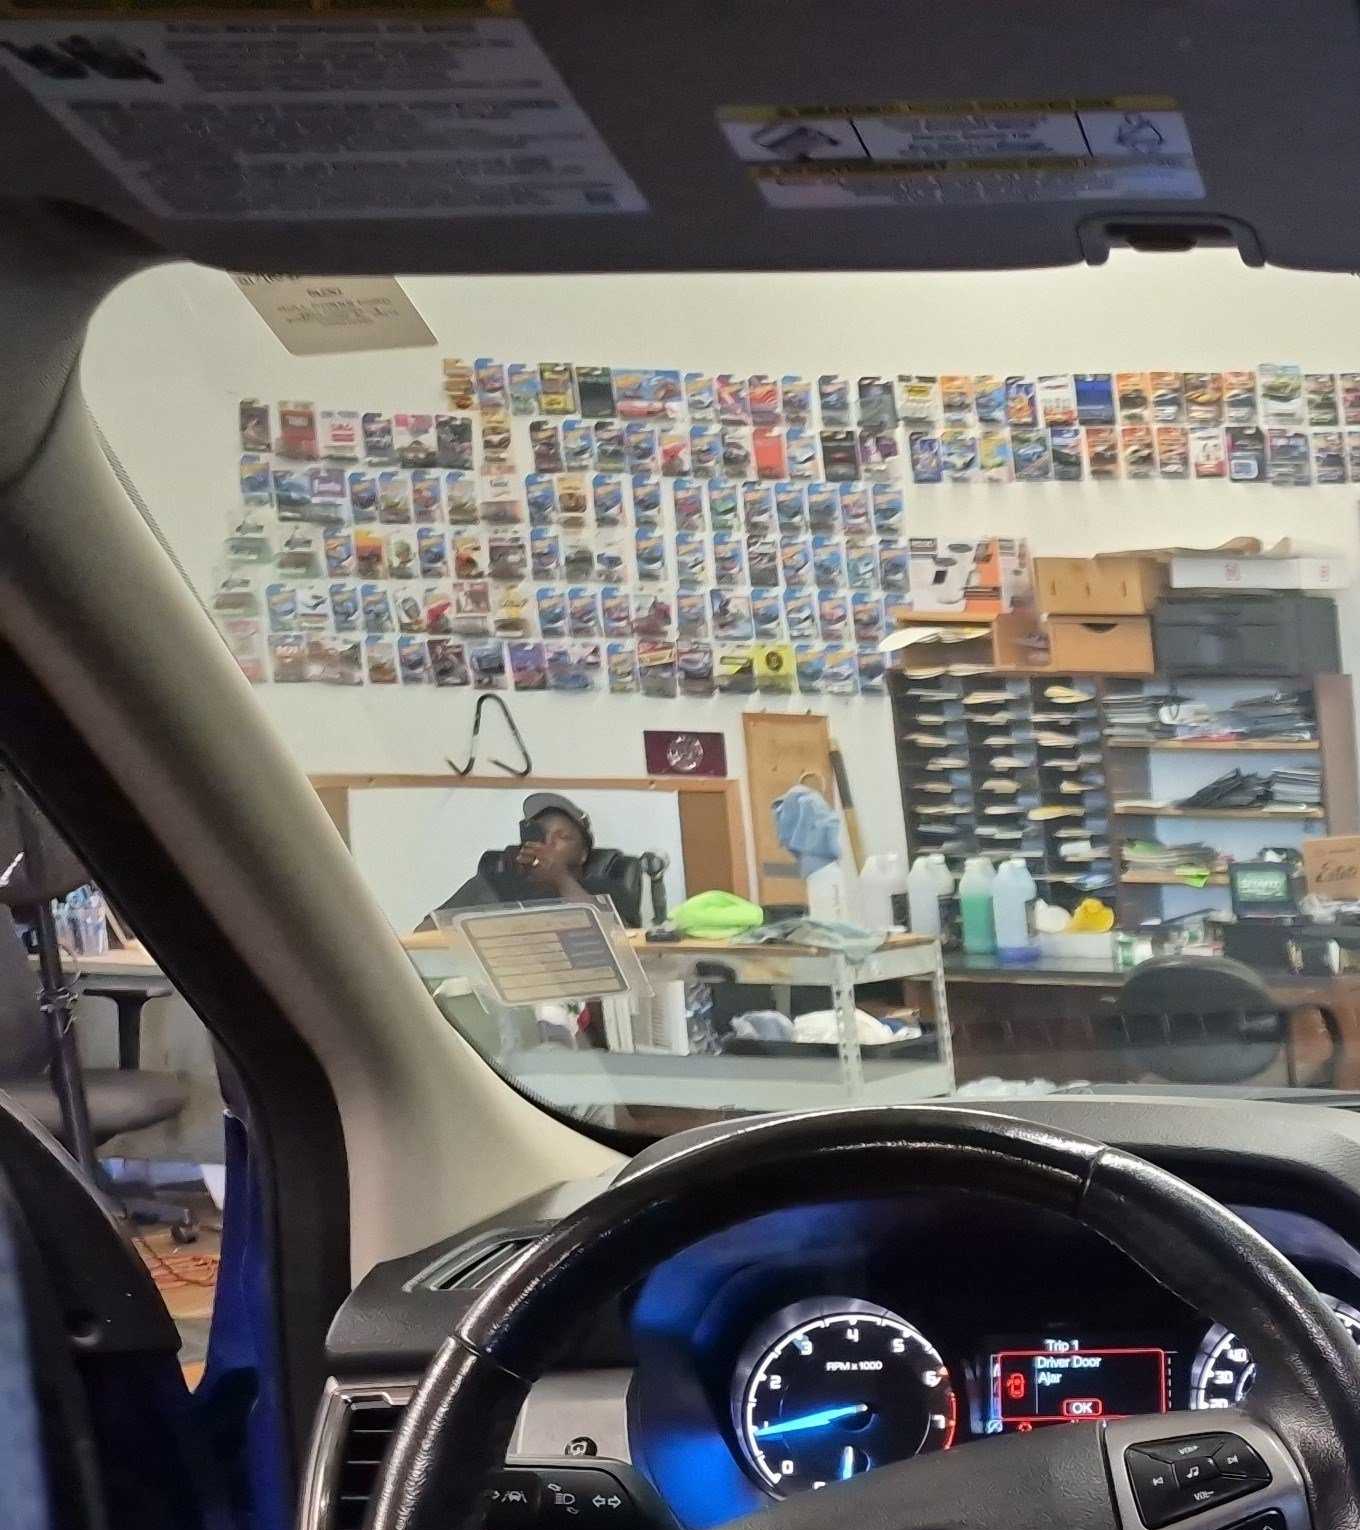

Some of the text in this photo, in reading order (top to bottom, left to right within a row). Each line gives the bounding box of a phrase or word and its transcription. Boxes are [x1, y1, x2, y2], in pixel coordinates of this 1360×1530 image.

[846, 1328, 859, 1343] 4
[800, 1340, 813, 1355] 3
[891, 1338, 905, 1353] 5
[1044, 1339, 1079, 1352] Trip 1
[1035, 1355, 1102, 1369] Driver Door
[1226, 1348, 1247, 1362] 40
[825, 1361, 850, 1371] RPM
[859, 1360, 883, 1370] 1000
[769, 1375, 782, 1389] 2
[922, 1370, 940, 1386] 6
[1037, 1372, 1062, 1386] Ajar
[1213, 1370, 1233, 1384] 30
[1071, 1402, 1093, 1414] OK
[781, 1460, 794, 1474] 0
